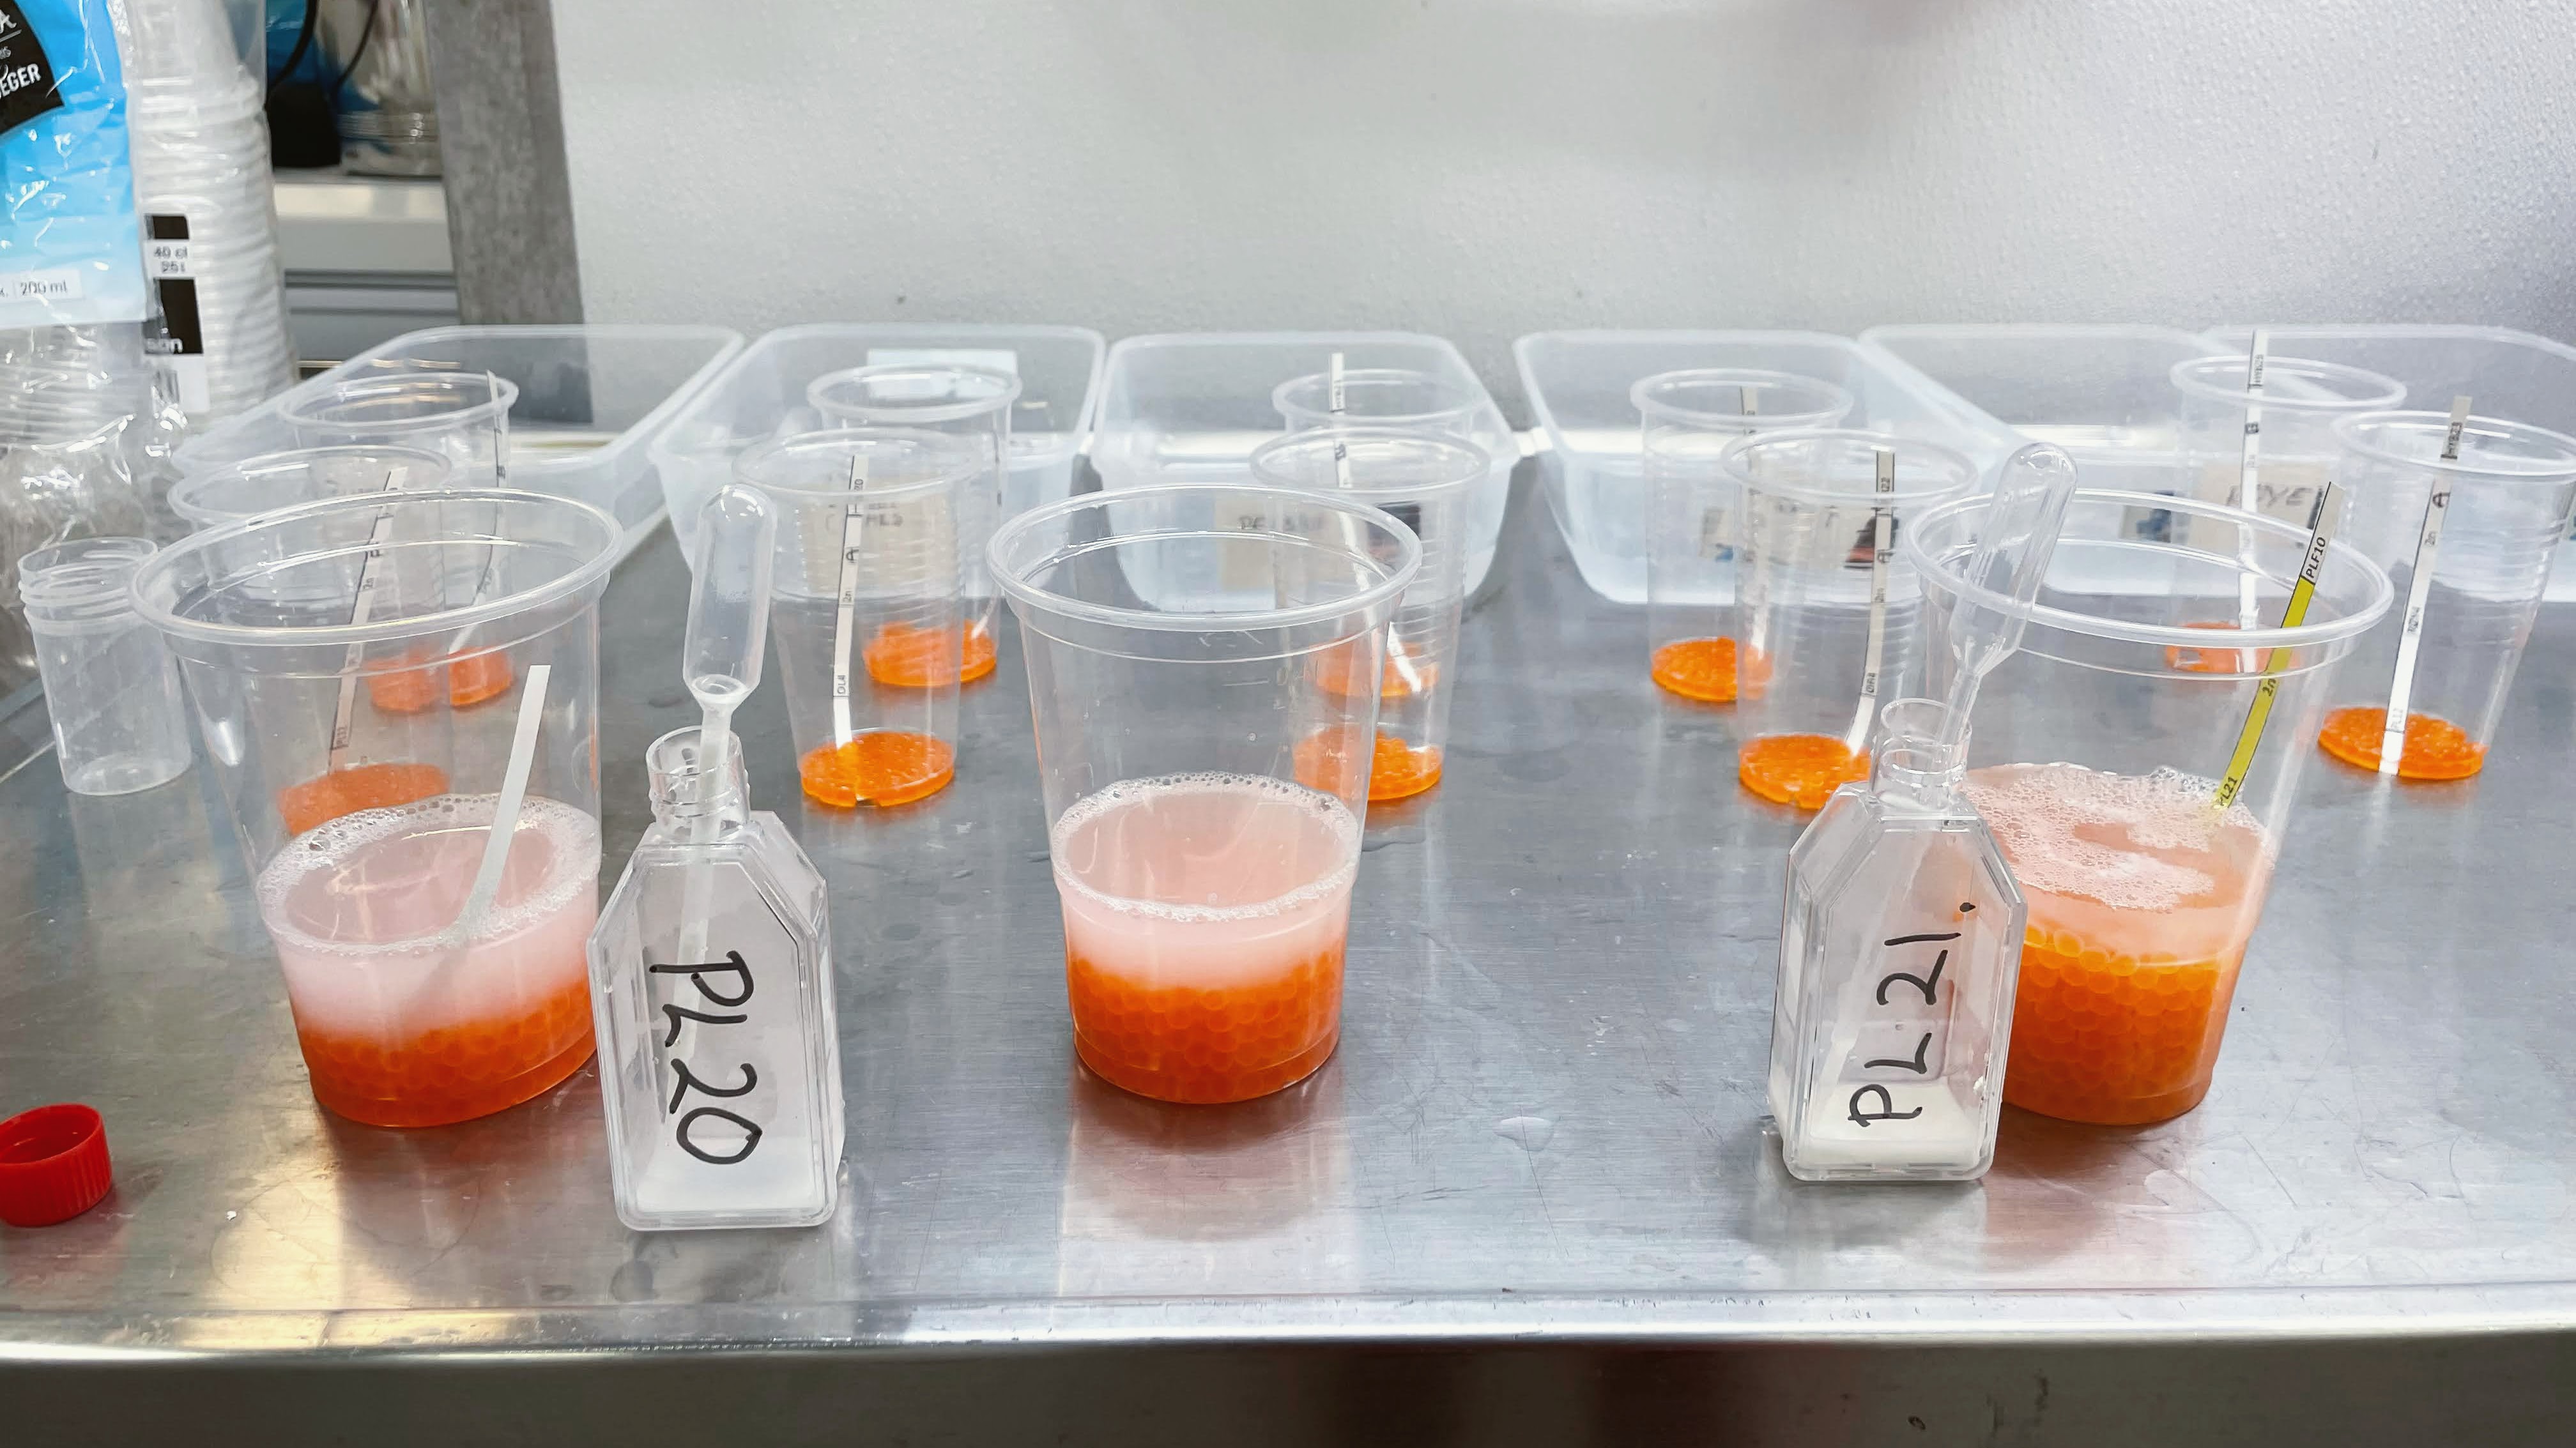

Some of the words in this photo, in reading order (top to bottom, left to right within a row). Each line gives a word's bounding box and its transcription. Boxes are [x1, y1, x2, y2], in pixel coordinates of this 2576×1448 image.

[0, 64, 41, 99] EGER
[2305, 536, 2327, 579] PLF10
[649, 950, 763, 1165] PL20
